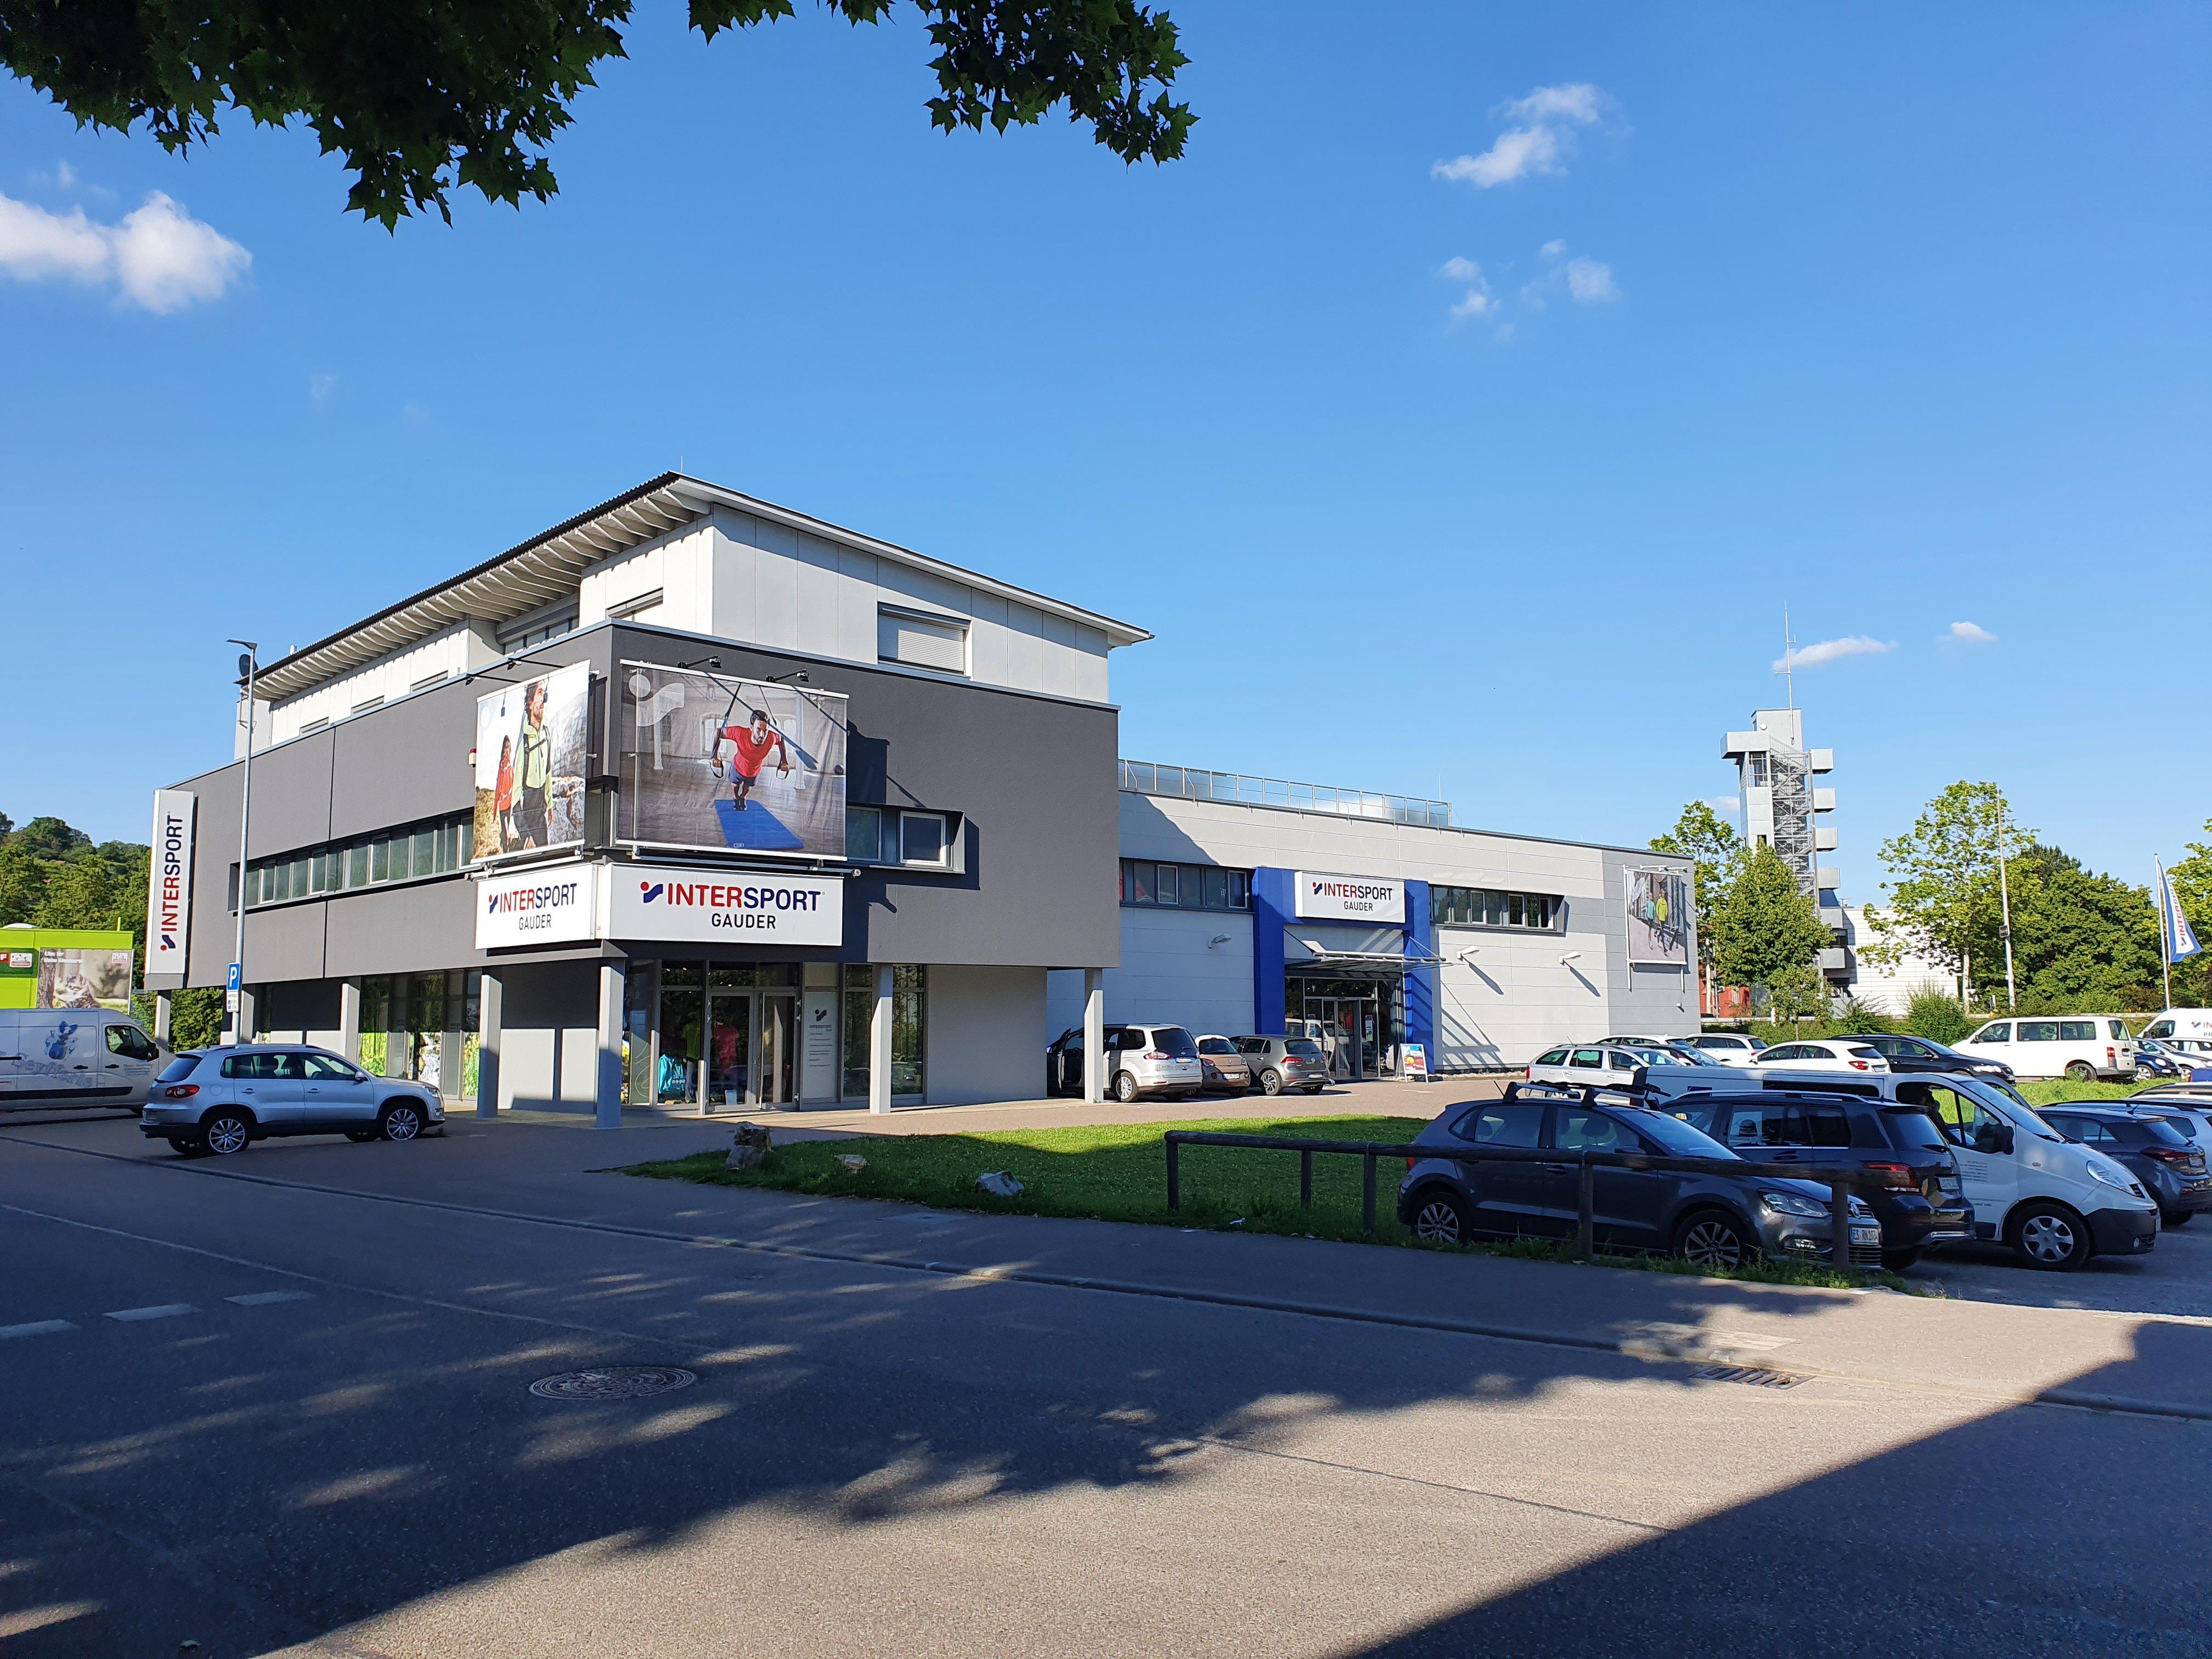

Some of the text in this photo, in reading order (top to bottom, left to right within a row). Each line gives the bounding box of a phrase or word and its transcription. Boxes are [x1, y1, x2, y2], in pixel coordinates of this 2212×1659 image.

[161, 815, 183, 932] INTERSPORT
[500, 883, 577, 913] INTERSPORT
[668, 883, 821, 911] INTERSPORT
[1324, 882, 1393, 901] INTERSPORT
[1344, 901, 1373, 912] GAUDER
[519, 914, 551, 930] GAUDER
[711, 913, 776, 929] GAUDER
[229, 966, 238, 988] P
